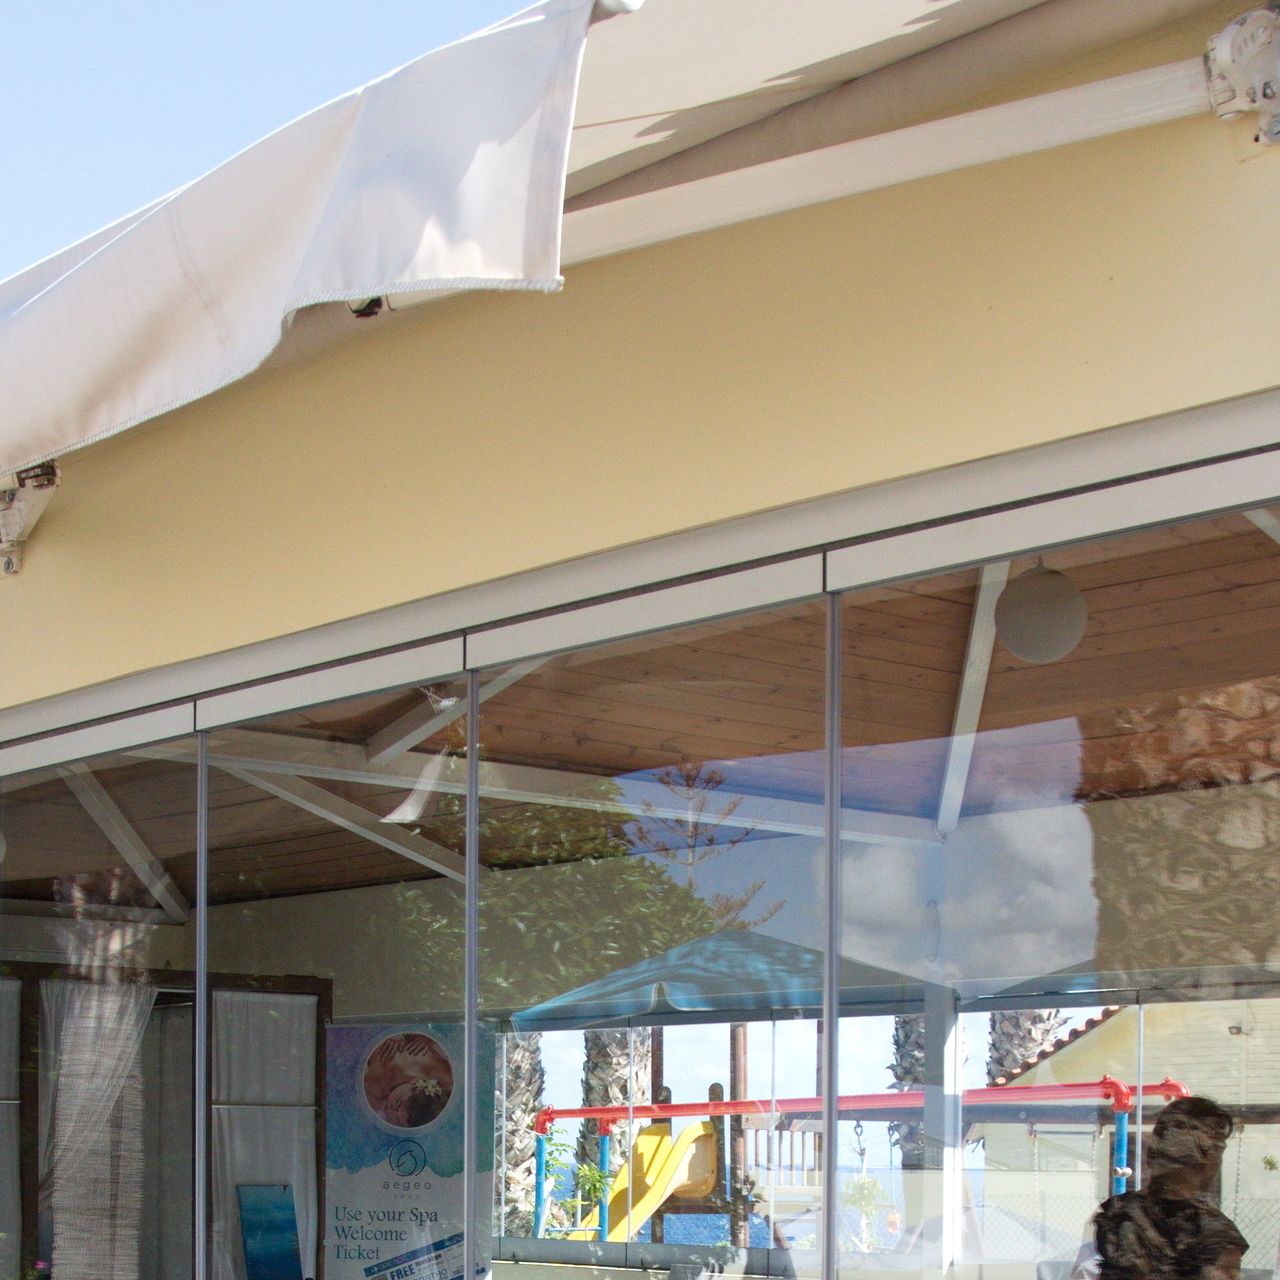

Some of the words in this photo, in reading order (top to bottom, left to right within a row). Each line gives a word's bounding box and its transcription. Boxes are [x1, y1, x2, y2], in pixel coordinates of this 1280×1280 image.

[382, 1180, 432, 1192] aegeo
[334, 1206, 363, 1222] Use
[367, 1209, 406, 1226] your
[409, 1207, 439, 1227] Spa
[334, 1225, 408, 1241] Welcome
[334, 1244, 380, 1260] Ticket
